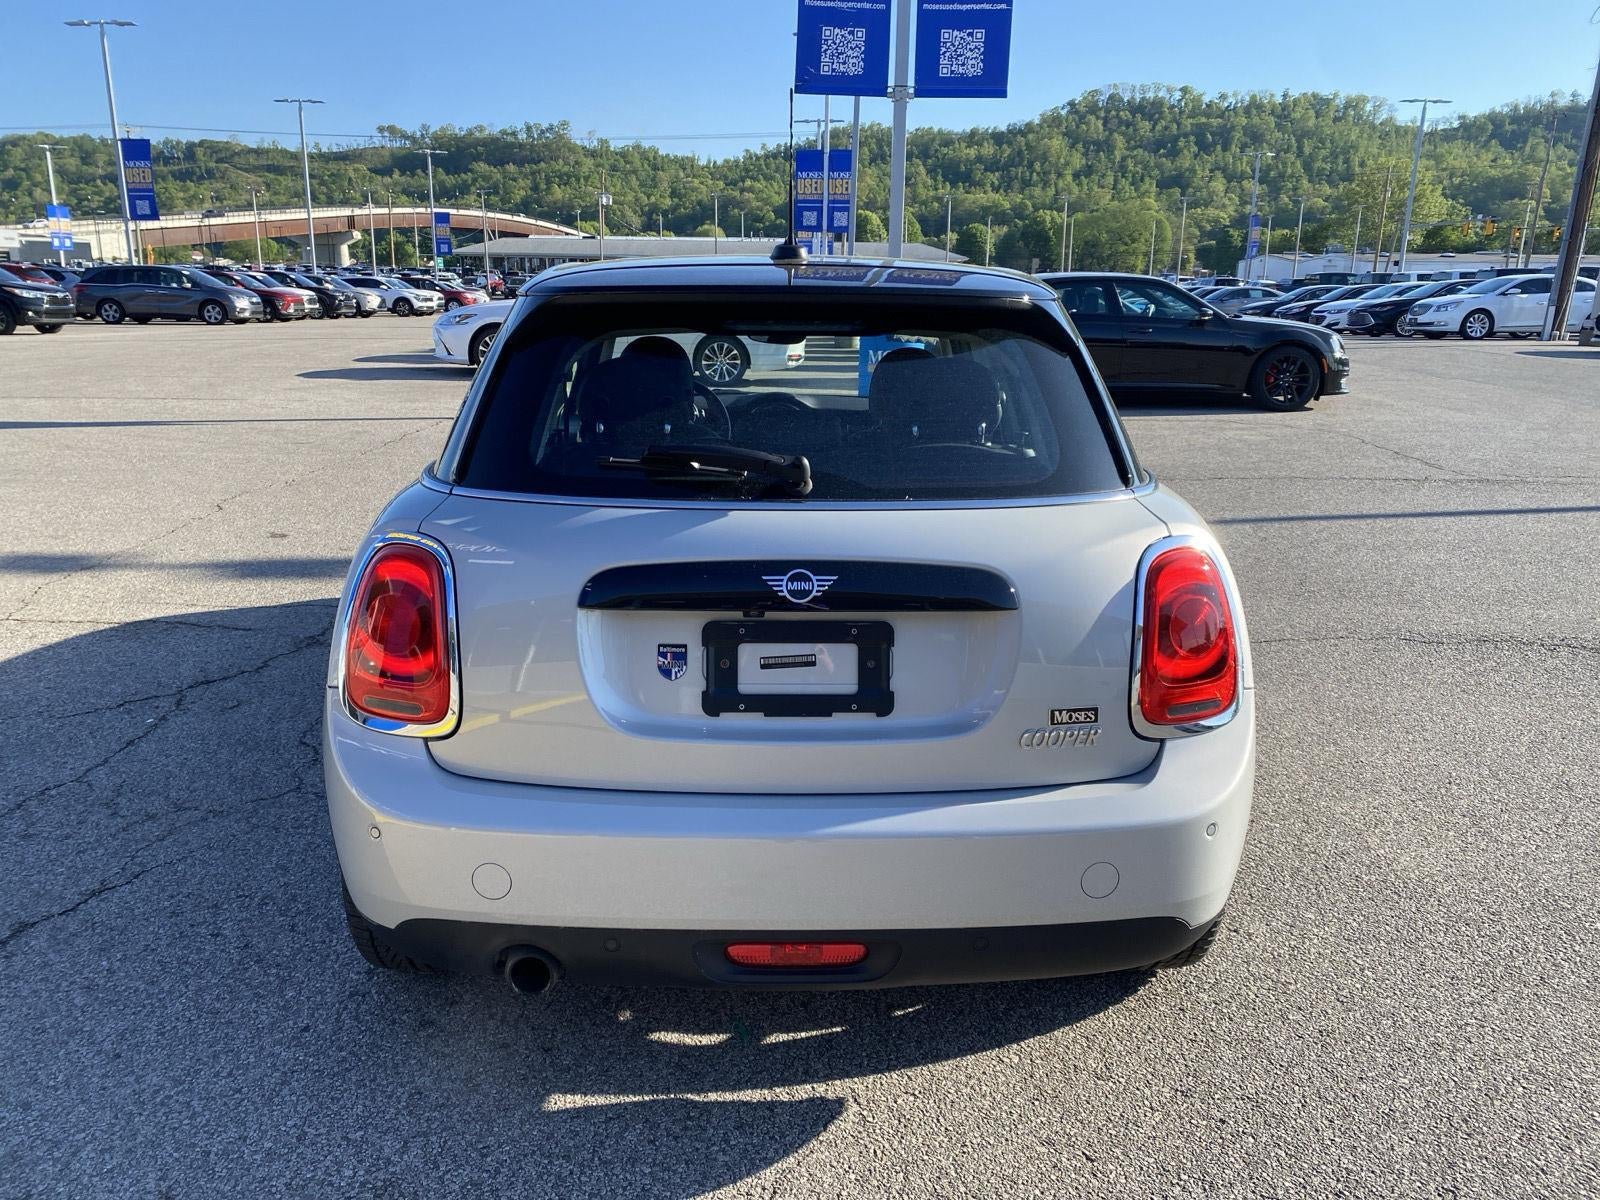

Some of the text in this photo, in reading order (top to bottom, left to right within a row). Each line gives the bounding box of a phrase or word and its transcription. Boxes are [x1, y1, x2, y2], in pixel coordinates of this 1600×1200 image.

[804, 0, 886, 10] mosesusedsupercenter.com
[126, 168, 152, 183] USED
[797, 171, 824, 179] MOSES
[829, 171, 852, 179] MOSE
[797, 179, 824, 194] USED
[787, 581, 813, 591] MINI
[1020, 726, 1102, 748] COOPER
